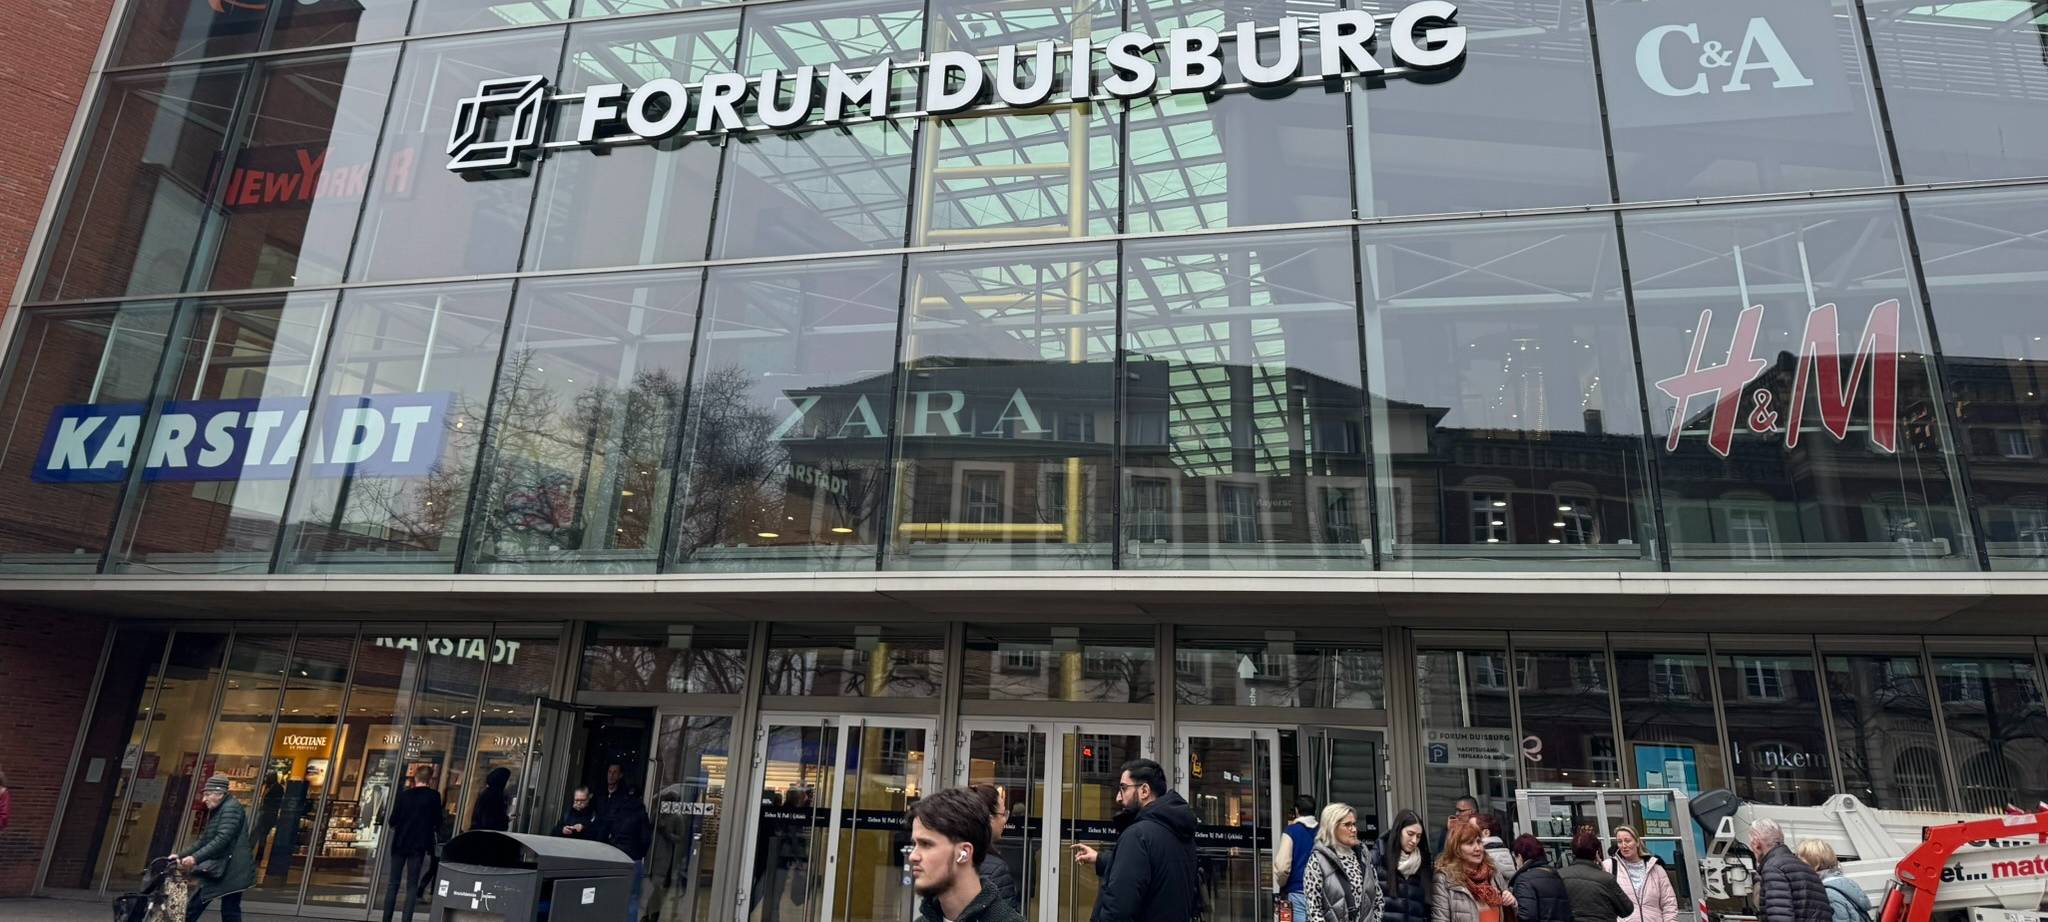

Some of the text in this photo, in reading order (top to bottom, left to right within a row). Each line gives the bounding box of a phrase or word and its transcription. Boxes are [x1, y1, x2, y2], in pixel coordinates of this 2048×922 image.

[577, 0, 1468, 145] FORUM DUISBURG
[1634, 16, 1814, 97] C&A
[1654, 298, 1900, 458] H&M
[47, 405, 432, 470] KARSTADT
[767, 387, 1053, 441] ZARA
[283, 734, 327, 746] L'OCCITANE
[1434, 749, 1443, 761] P
[1469, 733, 1511, 741] DUISBURG
[1992, 854, 2048, 879] mat
